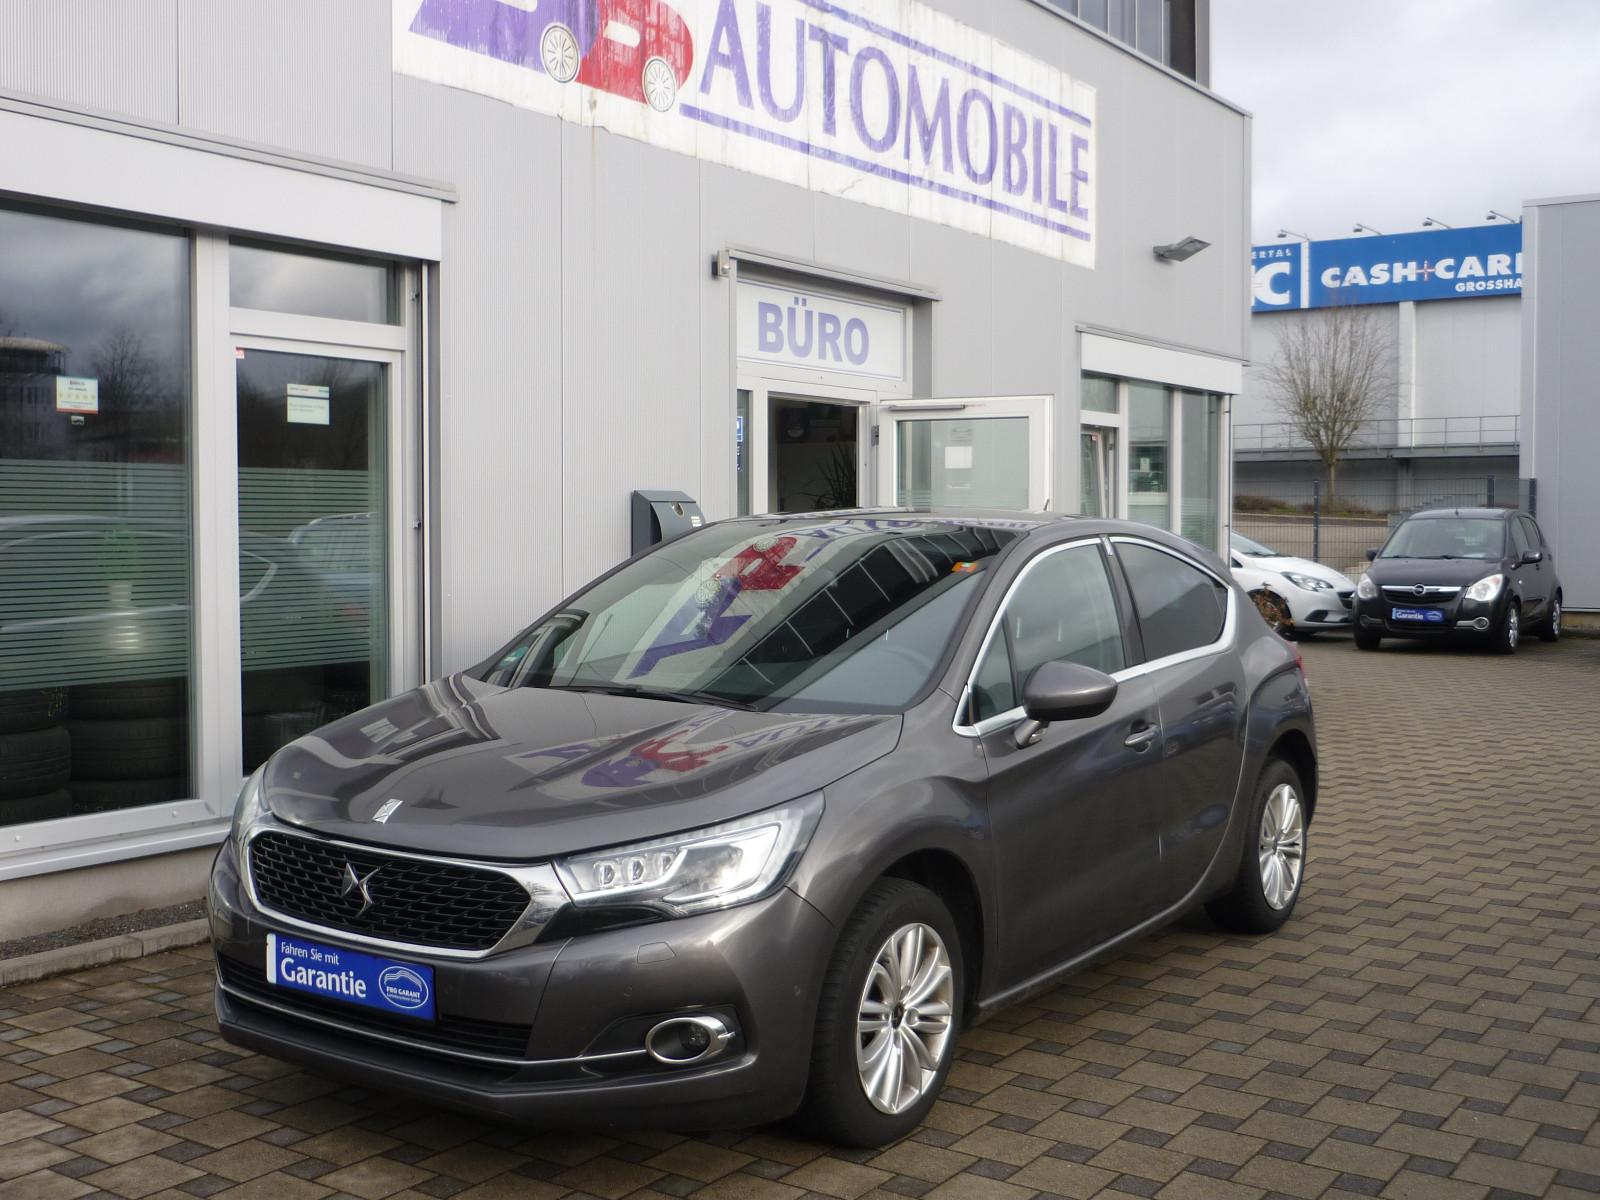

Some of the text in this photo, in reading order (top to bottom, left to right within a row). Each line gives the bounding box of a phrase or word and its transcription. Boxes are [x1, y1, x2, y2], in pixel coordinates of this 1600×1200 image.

[700, 0, 1089, 220] AUTOMOBILE
[1322, 253, 1523, 287] CASH+CAR
[758, 297, 869, 365] BÜRO
[281, 942, 339, 965] Fahren Sie mit
[281, 957, 367, 997] Garantie
